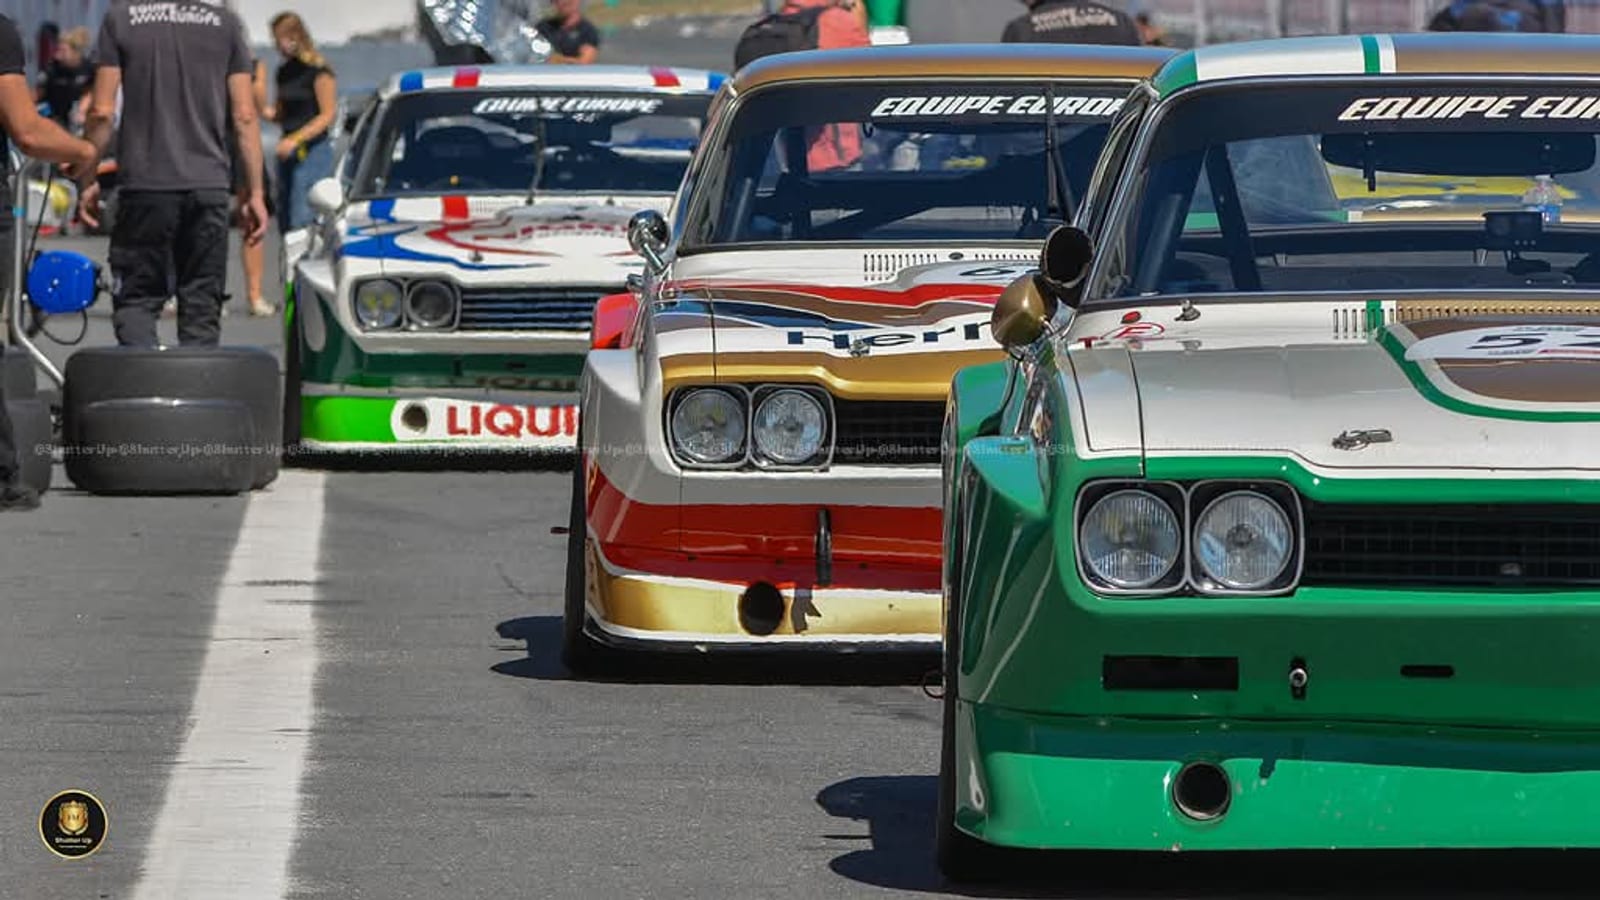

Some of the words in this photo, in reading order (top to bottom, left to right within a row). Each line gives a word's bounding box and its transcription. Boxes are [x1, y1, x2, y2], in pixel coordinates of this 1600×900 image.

[871, 96, 1013, 116] EQUIPE
[1338, 96, 1528, 121] EQUIPE
[447, 404, 576, 438] LIQUI
